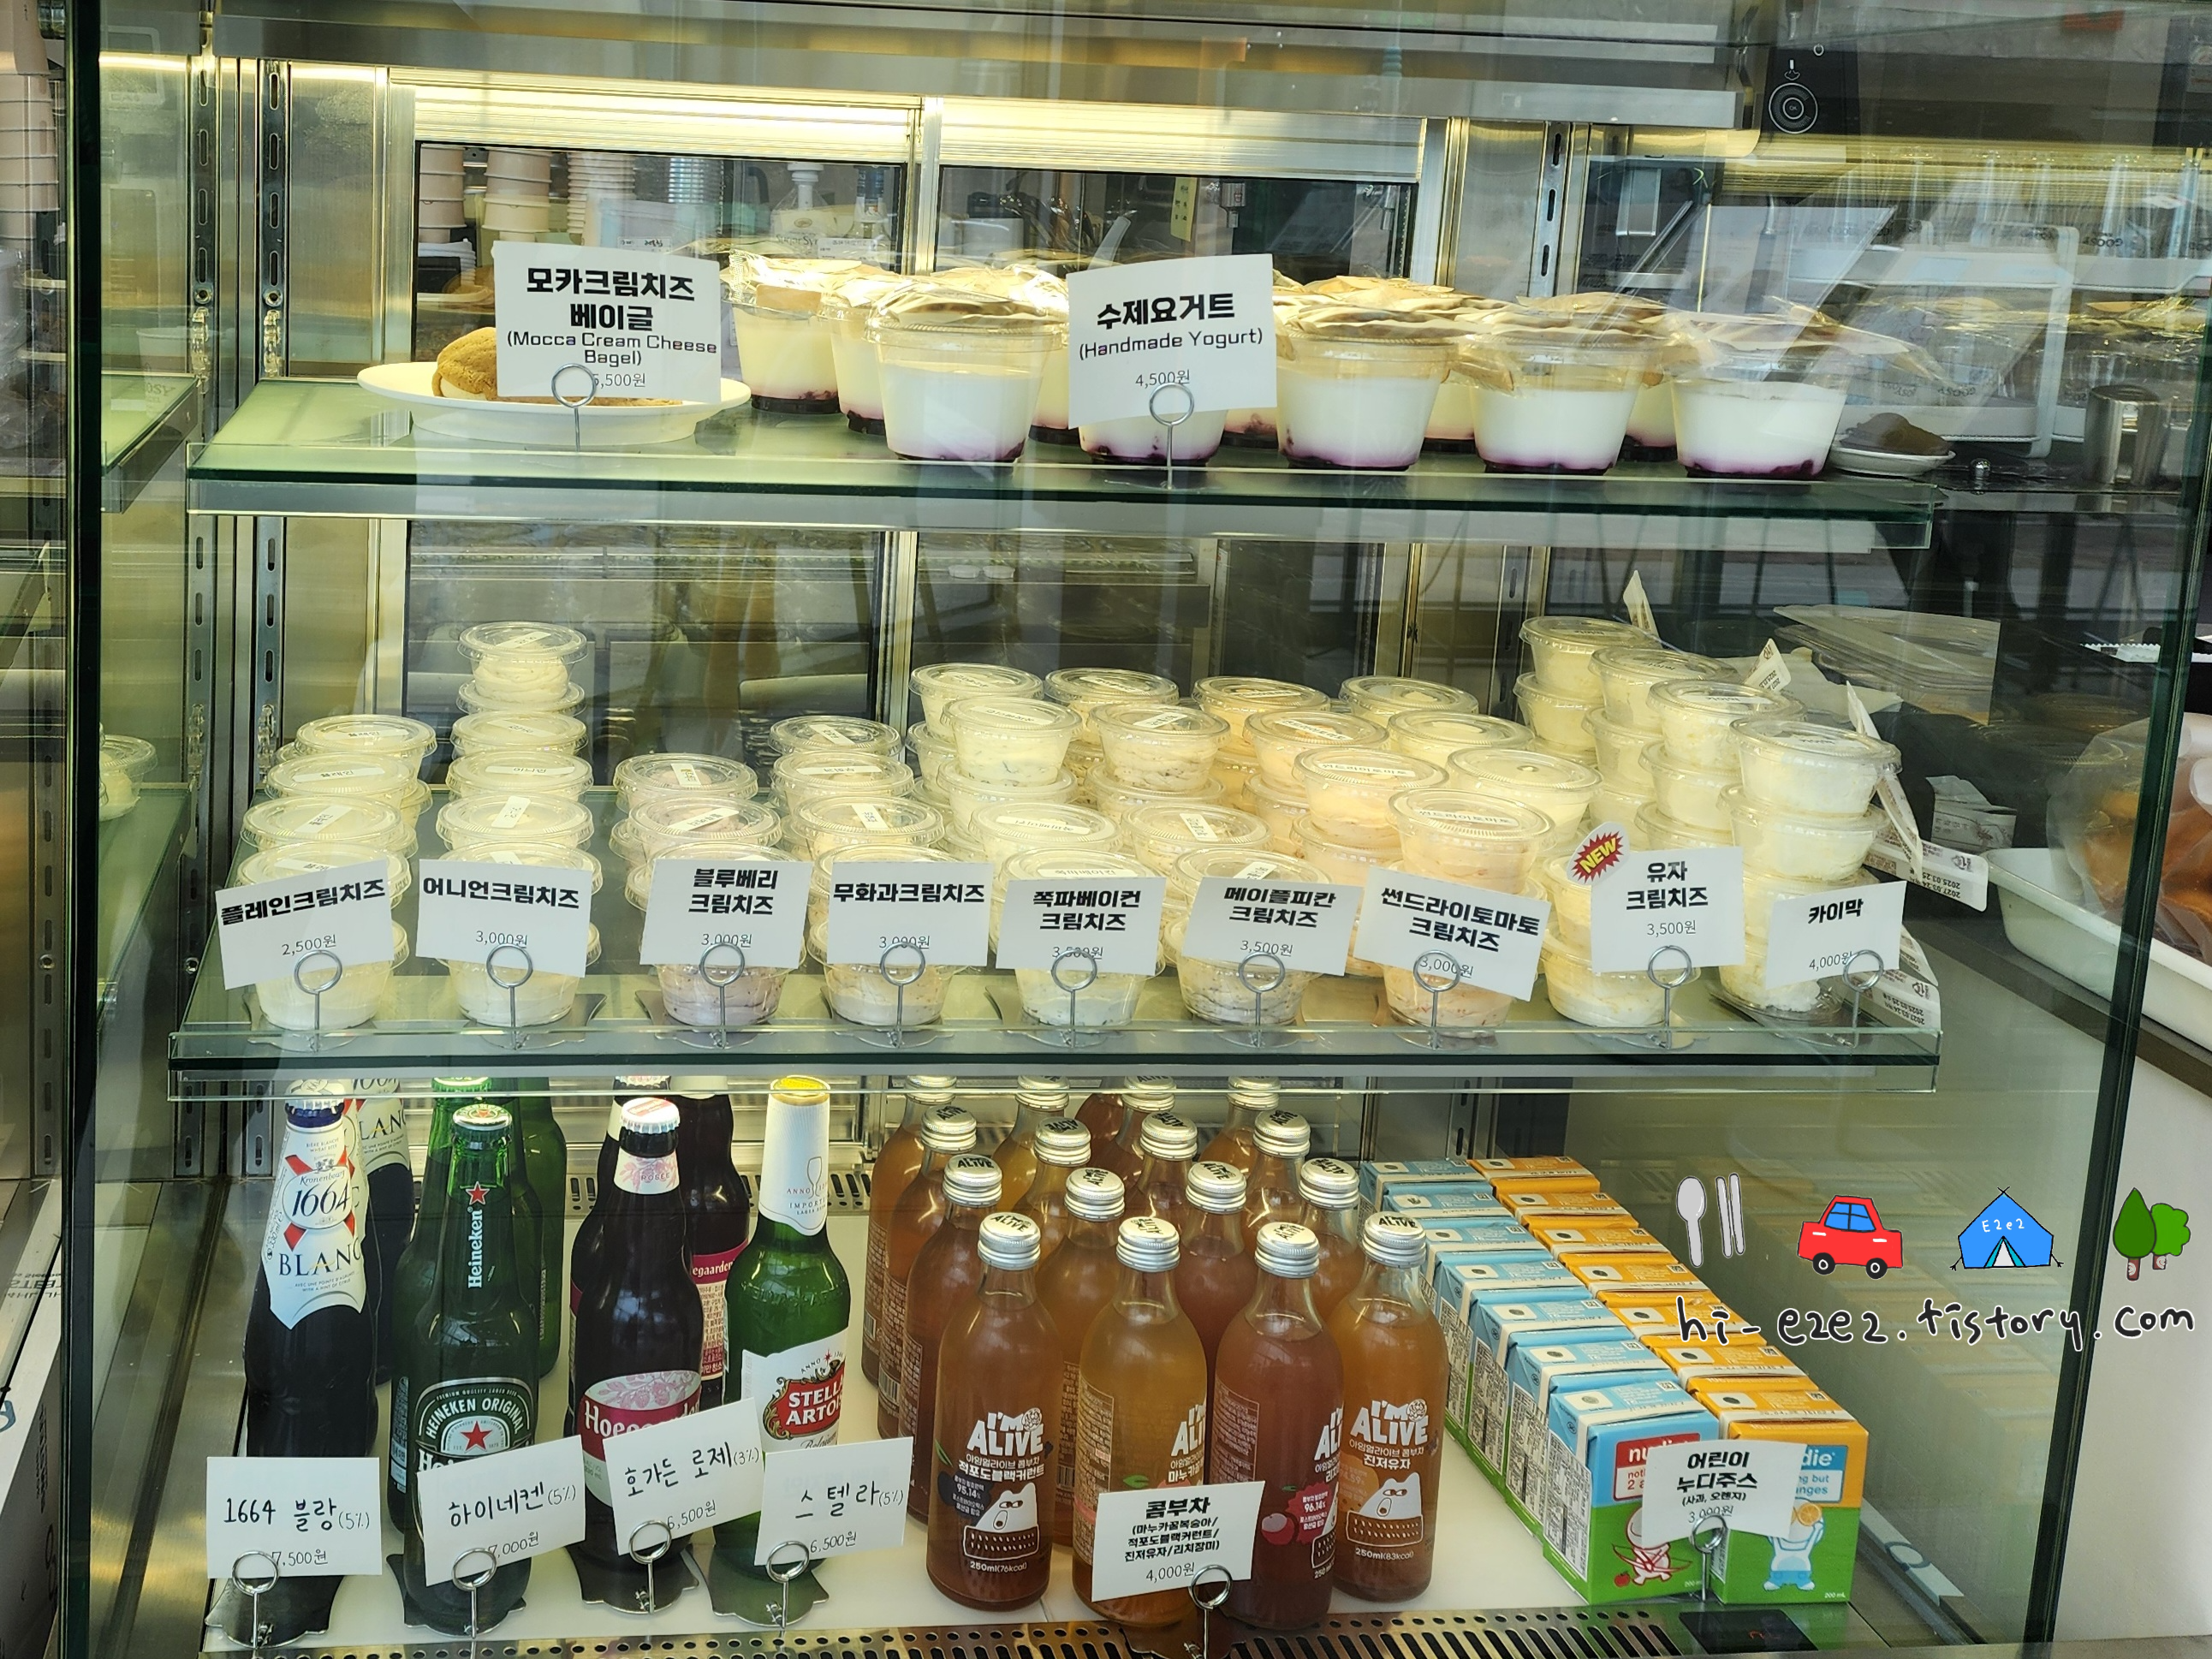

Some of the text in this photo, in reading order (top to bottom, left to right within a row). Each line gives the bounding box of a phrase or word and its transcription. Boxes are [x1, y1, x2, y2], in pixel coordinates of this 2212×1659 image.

[526, 267, 695, 301] 모카크림치즈
[570, 303, 654, 331] 베이글
[1097, 293, 1235, 330] 수제요거트
[508, 330, 717, 354] (Mocca Cream Cheese
[1079, 327, 1263, 361] (Handmade Yogurt)
[585, 349, 642, 368] Bagel)
[1135, 368, 1190, 389] 4,500원
[1578, 836, 1618, 875] NEW
[693, 868, 779, 891] 블루베리
[1647, 860, 1688, 884] 유자
[221, 878, 386, 927] 플레인크림치즈
[423, 877, 580, 911] 어니언크림치즈
[688, 893, 775, 916] 크림치즈
[833, 883, 986, 905] 무화과크림치즈
[1032, 889, 1142, 911] 쪽파베이컨
[1223, 886, 1337, 910] 메이플피칸
[1626, 885, 1710, 912] 크림치즈
[1039, 911, 1127, 933] 크림치즈
[1228, 906, 1319, 929] 크림치즈
[1381, 887, 1541, 937] 썬드라이토마토
[1808, 897, 1864, 925] 카이막
[475, 930, 528, 950] 3,000원
[1409, 916, 1501, 954] 크림치즈
[1646, 919, 1697, 937] 3,500원
[281, 932, 336, 957] 2,500원
[1240, 938, 1294, 959] 3,500원
[1418, 955, 1474, 980] 3,000원
[292, 1180, 352, 1217] 1664
[279, 1238, 362, 1276] BLANC
[467, 1209, 483, 1288] Heineken
[425, 1397, 477, 1440] HEINEKEN
[481, 1397, 525, 1435] ORIGINAL
[1350, 1406, 1429, 1446] ALIVE
[966, 1419, 1044, 1457] ALIVE
[958, 1459, 1045, 1483] 적포도블랙커런트
[1363, 1454, 1411, 1470] 진저유자
[1687, 1451, 1751, 1470] 어린이
[624, 1459, 680, 1498] 호가든
[1677, 1472, 1758, 1494] 누디주스
[1811, 1474, 1829, 1484] but
[223, 1497, 276, 1525] 1664
[1145, 1496, 1211, 1519] 콤부차
[1682, 1491, 1747, 1507] (사과, 오렌지)
[666, 1499, 717, 1531] 6,500원
[1132, 1516, 1219, 1537] (마누카꿀복숭아/
[809, 1530, 857, 1555] 6,500원
[1127, 1528, 1220, 1549] 적포도블랙커런트/
[1124, 1540, 1221, 1562] 진저유자/리치장미)
[1145, 1561, 1195, 1584] 4,000원
